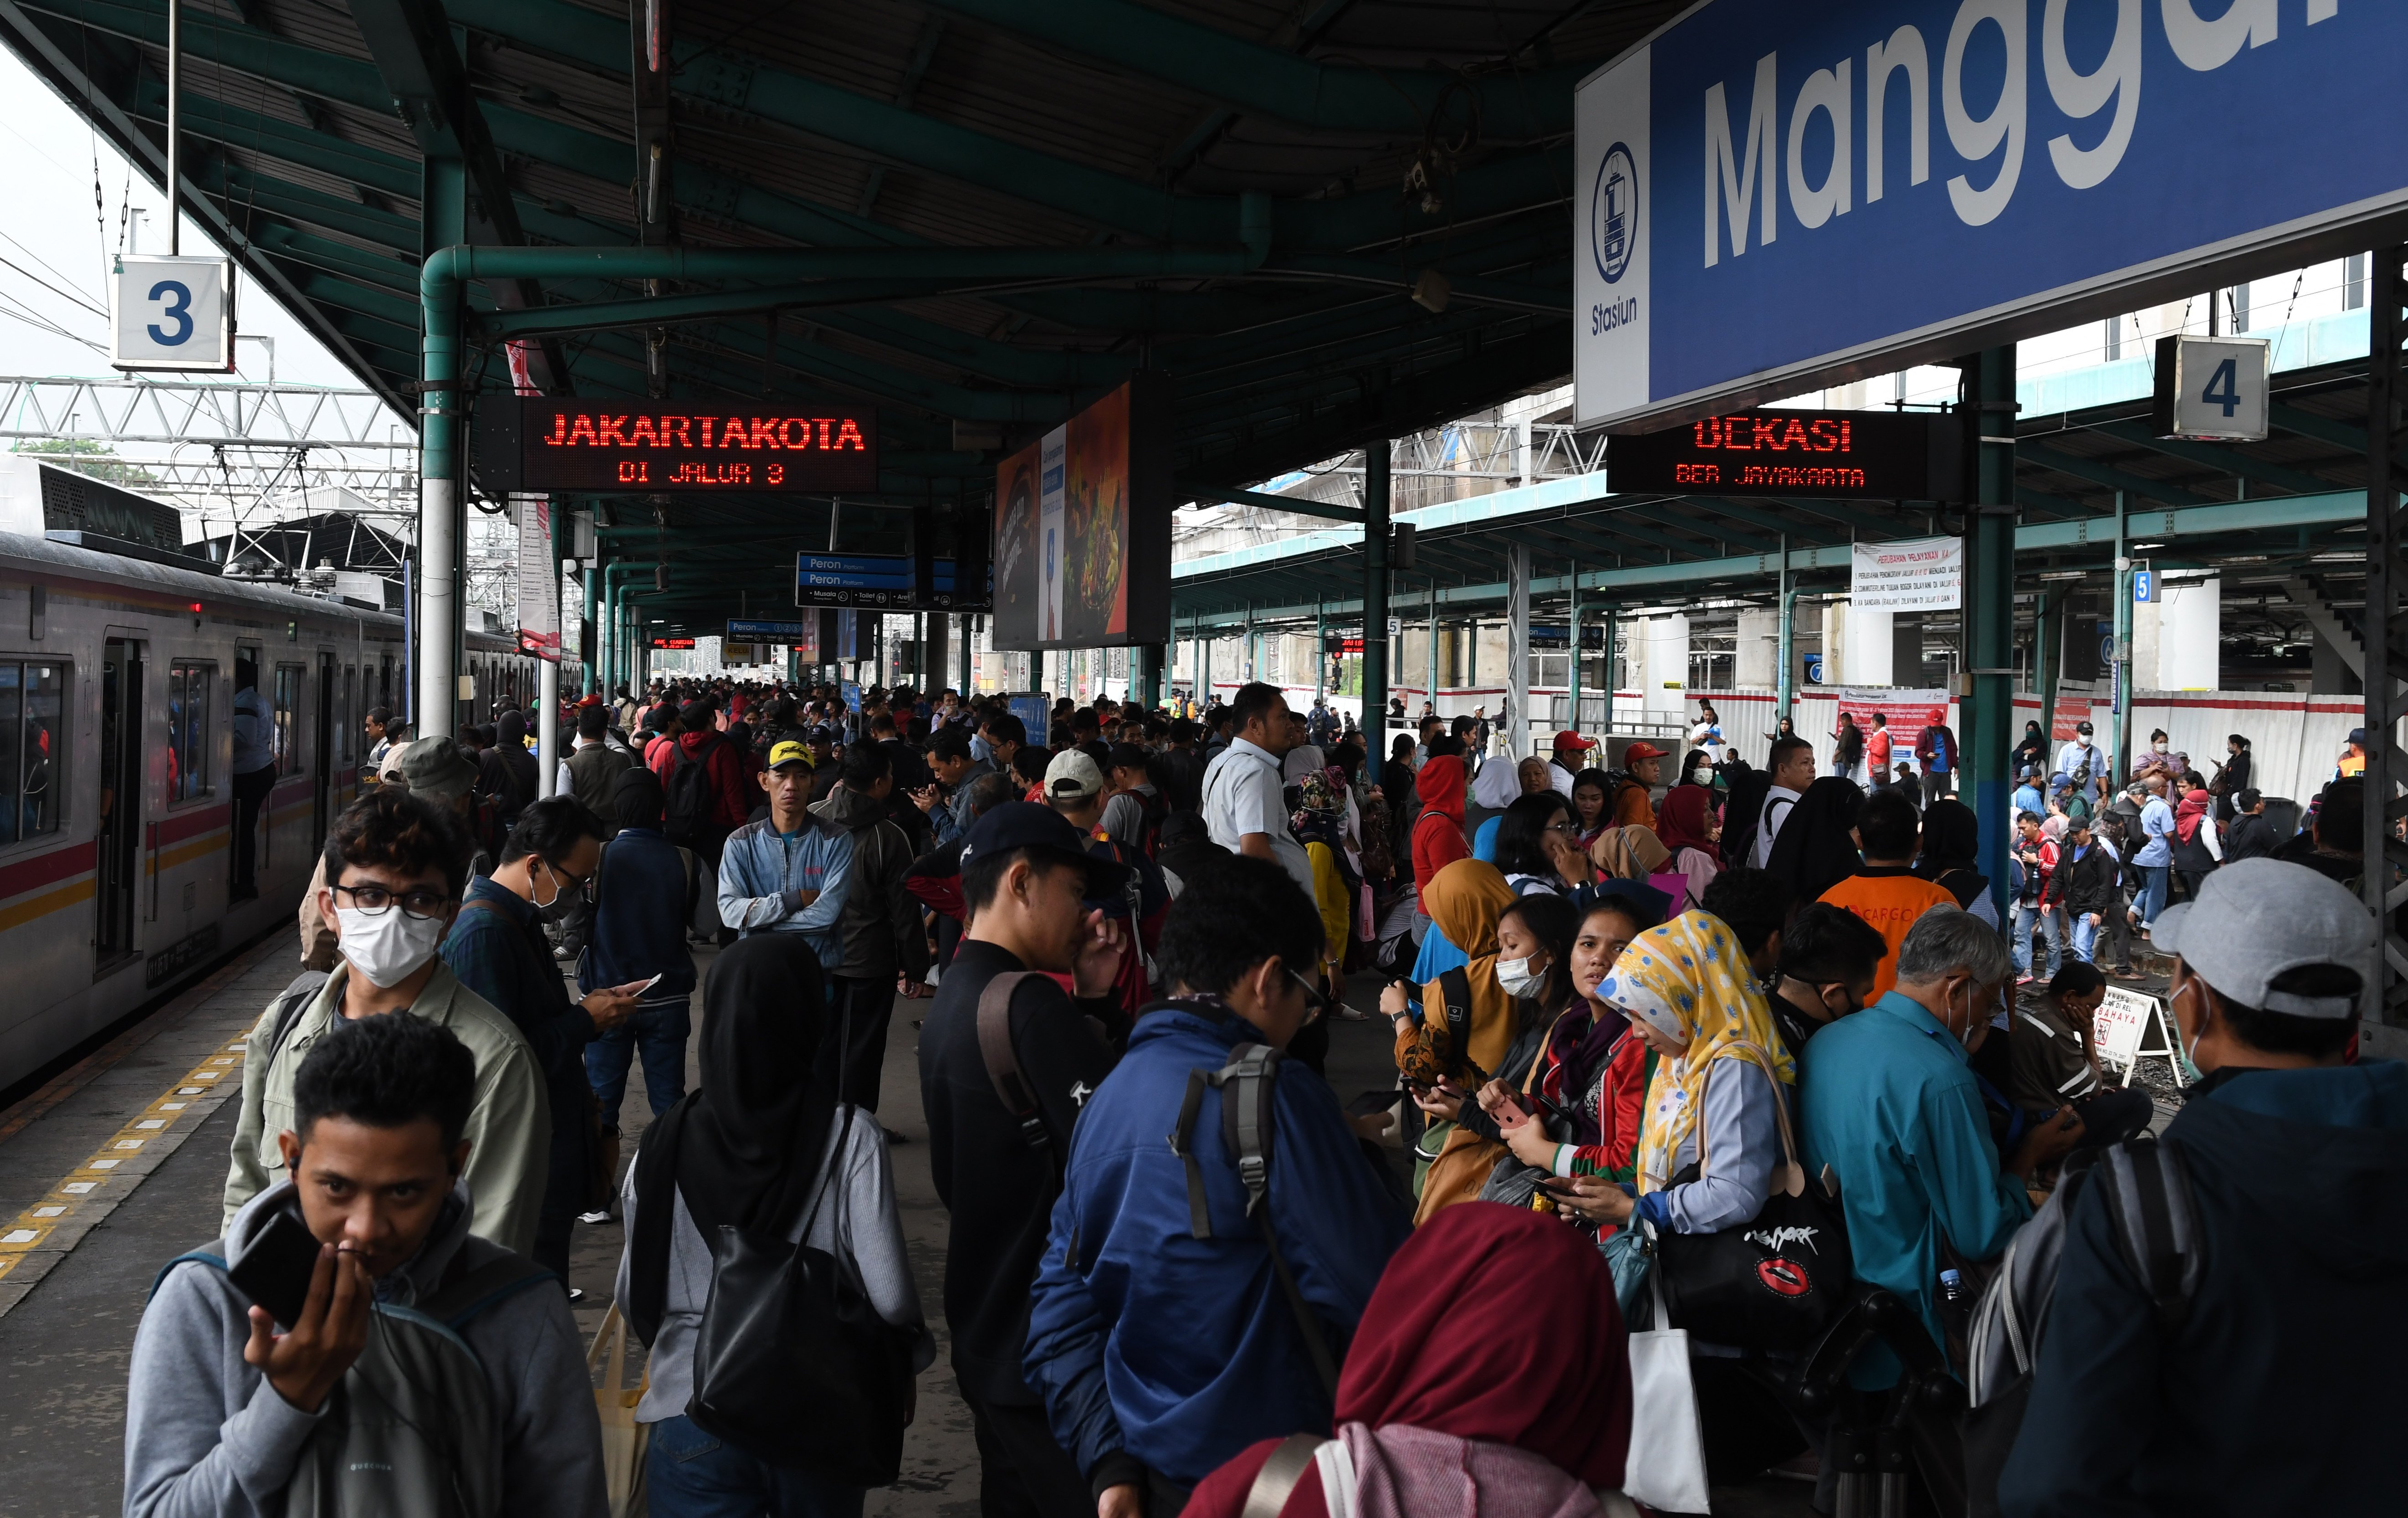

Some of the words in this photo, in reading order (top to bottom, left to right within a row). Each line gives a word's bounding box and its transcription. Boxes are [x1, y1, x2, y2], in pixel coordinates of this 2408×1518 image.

[1705, 0, 2338, 269] Mangg
[147, 280, 194, 347] 3
[1592, 295, 1637, 336] Stasiun
[2202, 359, 2240, 418] 4
[544, 414, 864, 450] JAKARTAKOTA
[1694, 416, 1850, 452] BEKASI
[619, 461, 648, 482] DI
[669, 462, 751, 484] JALUR
[767, 463, 783, 484] 3
[810, 559, 841, 569] Peron
[1877, 554, 1906, 564] PERUBAHAN
[1907, 550, 1938, 562] PELAYANAN
[1928, 566, 1947, 575] MENJADI
[809, 574, 840, 585] Peron
[1913, 581, 1932, 590] DILAYANI
[1939, 580, 1951, 588] JALUR
[2138, 576, 2147, 599] 5
[1901, 597, 1918, 605] DILAYANI
[733, 623, 757, 631] Peron
[1389, 621, 1397, 632] 5
[2105, 641, 2113, 660] 6
[1816, 667, 1822, 679] 7
[1864, 908, 1913, 922] CARGO
[2107, 992, 2130, 1003] ARANG
[2101, 999, 2114, 1007] ALAN
[2122, 1004, 2131, 1012] REL
[2094, 1007, 2136, 1025] BAHAYA
[350, 1463, 391, 1471] QUECHUA
